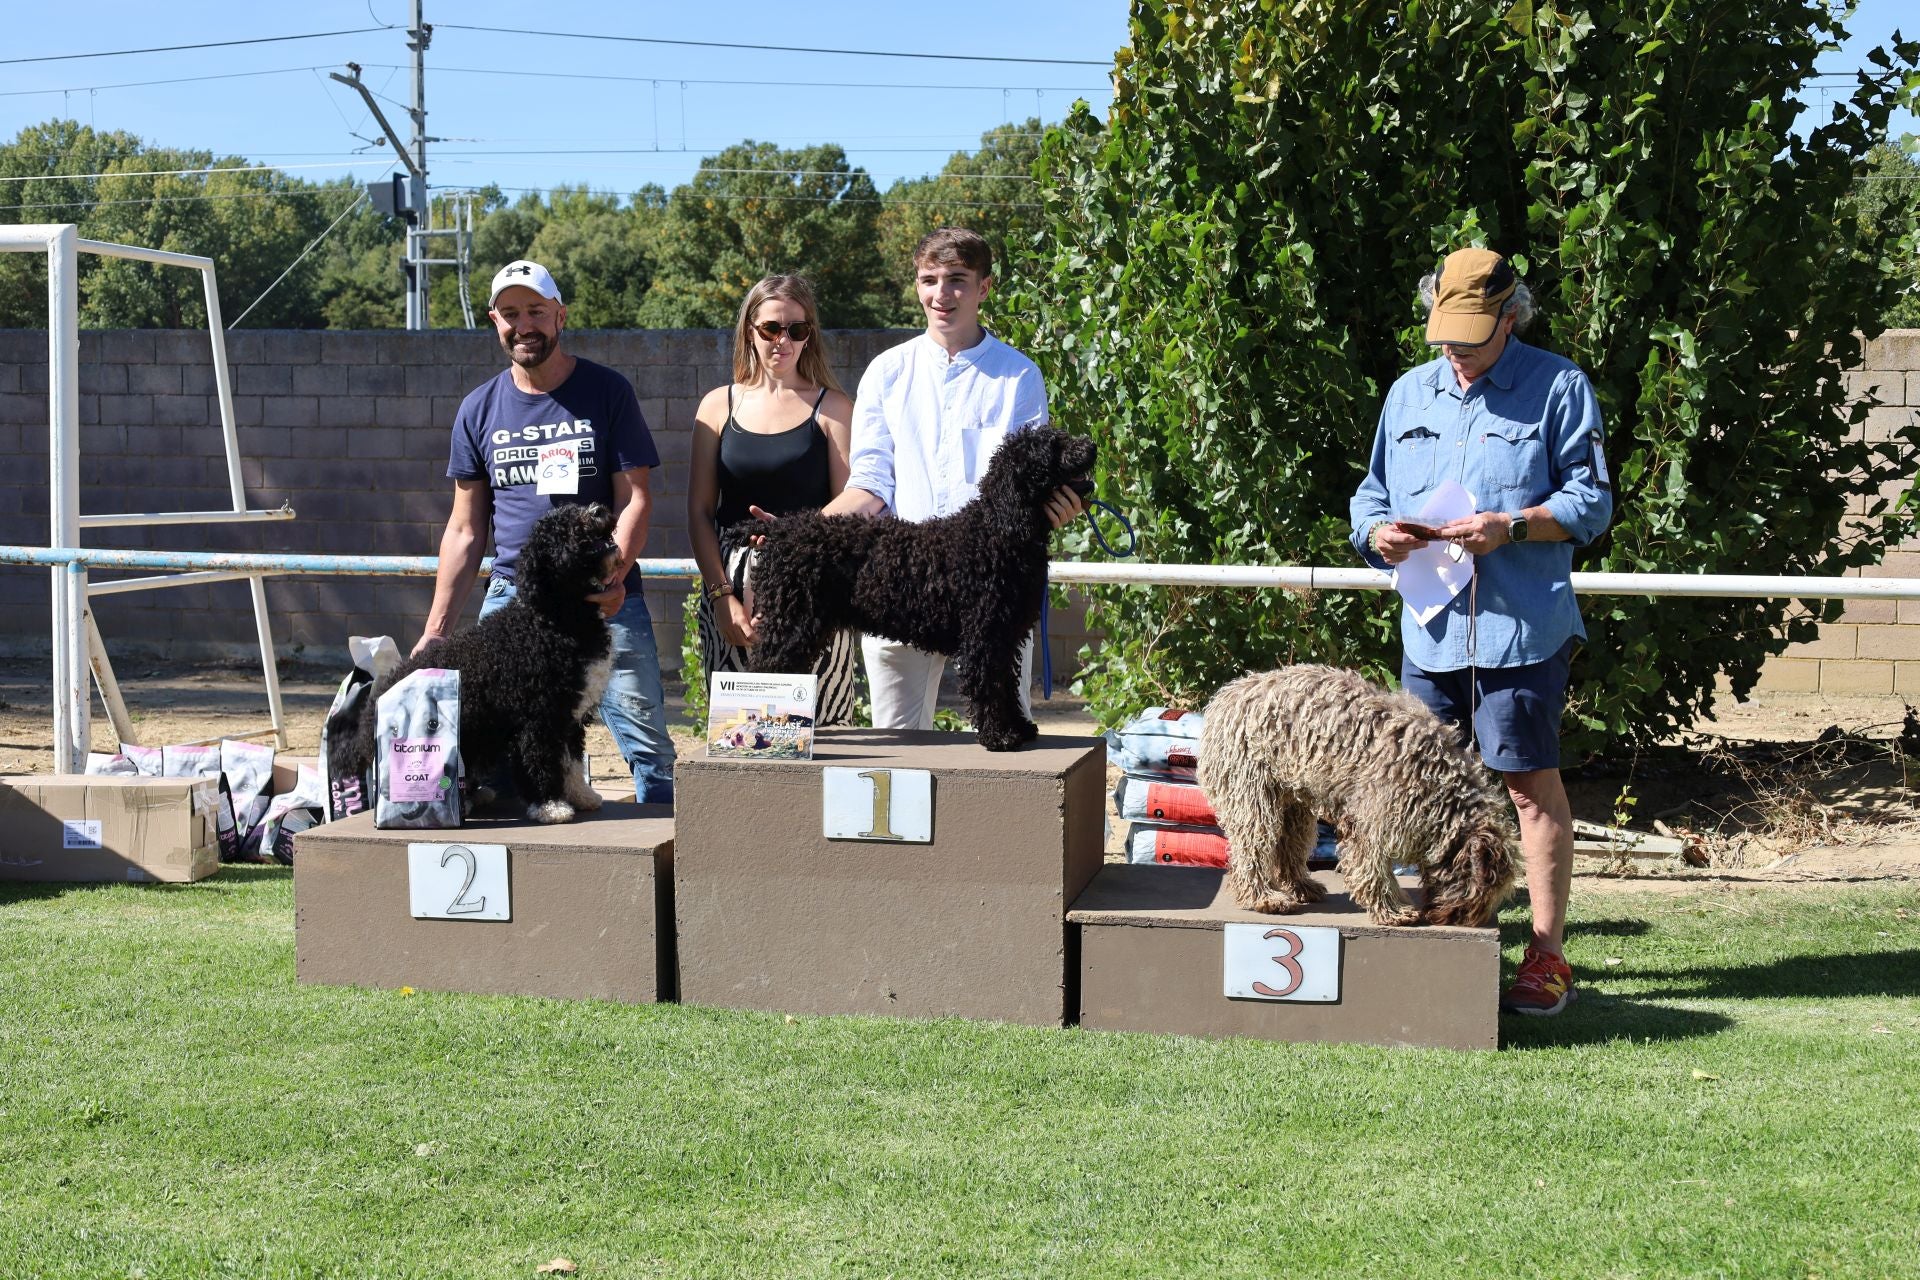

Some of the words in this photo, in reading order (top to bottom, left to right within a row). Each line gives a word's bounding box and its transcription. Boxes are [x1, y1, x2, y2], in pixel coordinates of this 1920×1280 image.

[492, 419, 593, 444] G-STAR
[496, 439, 592, 461] ORIGS
[541, 448, 575, 462] ARION
[494, 464, 540, 487] RAW
[543, 464, 569, 478] 63
[720, 681, 735, 690] VII
[773, 720, 801, 730] CLASE
[394, 743, 441, 753] titanium
[405, 773, 430, 782] GOAT
[331, 781, 342, 811] GOAT
[858, 769, 904, 840] 1
[440, 844, 486, 914] 2
[1252, 928, 1304, 997] 3
